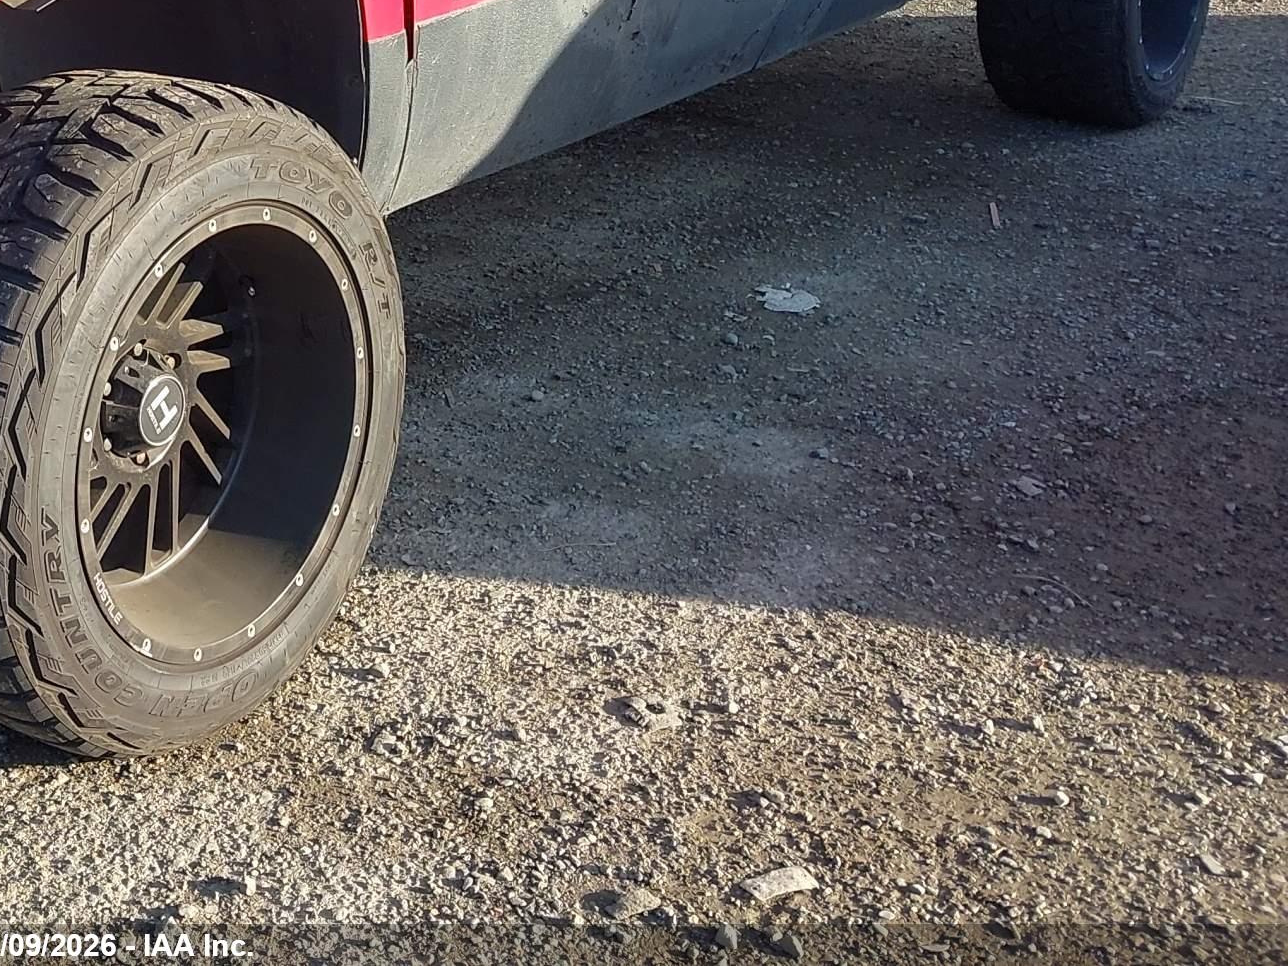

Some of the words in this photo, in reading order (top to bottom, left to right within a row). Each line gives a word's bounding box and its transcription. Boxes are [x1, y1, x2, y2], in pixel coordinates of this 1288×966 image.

[250, 157, 353, 219] TOYO
[40, 505, 145, 707] COUNTRY
[93, 572, 123, 626] HOSTILE
